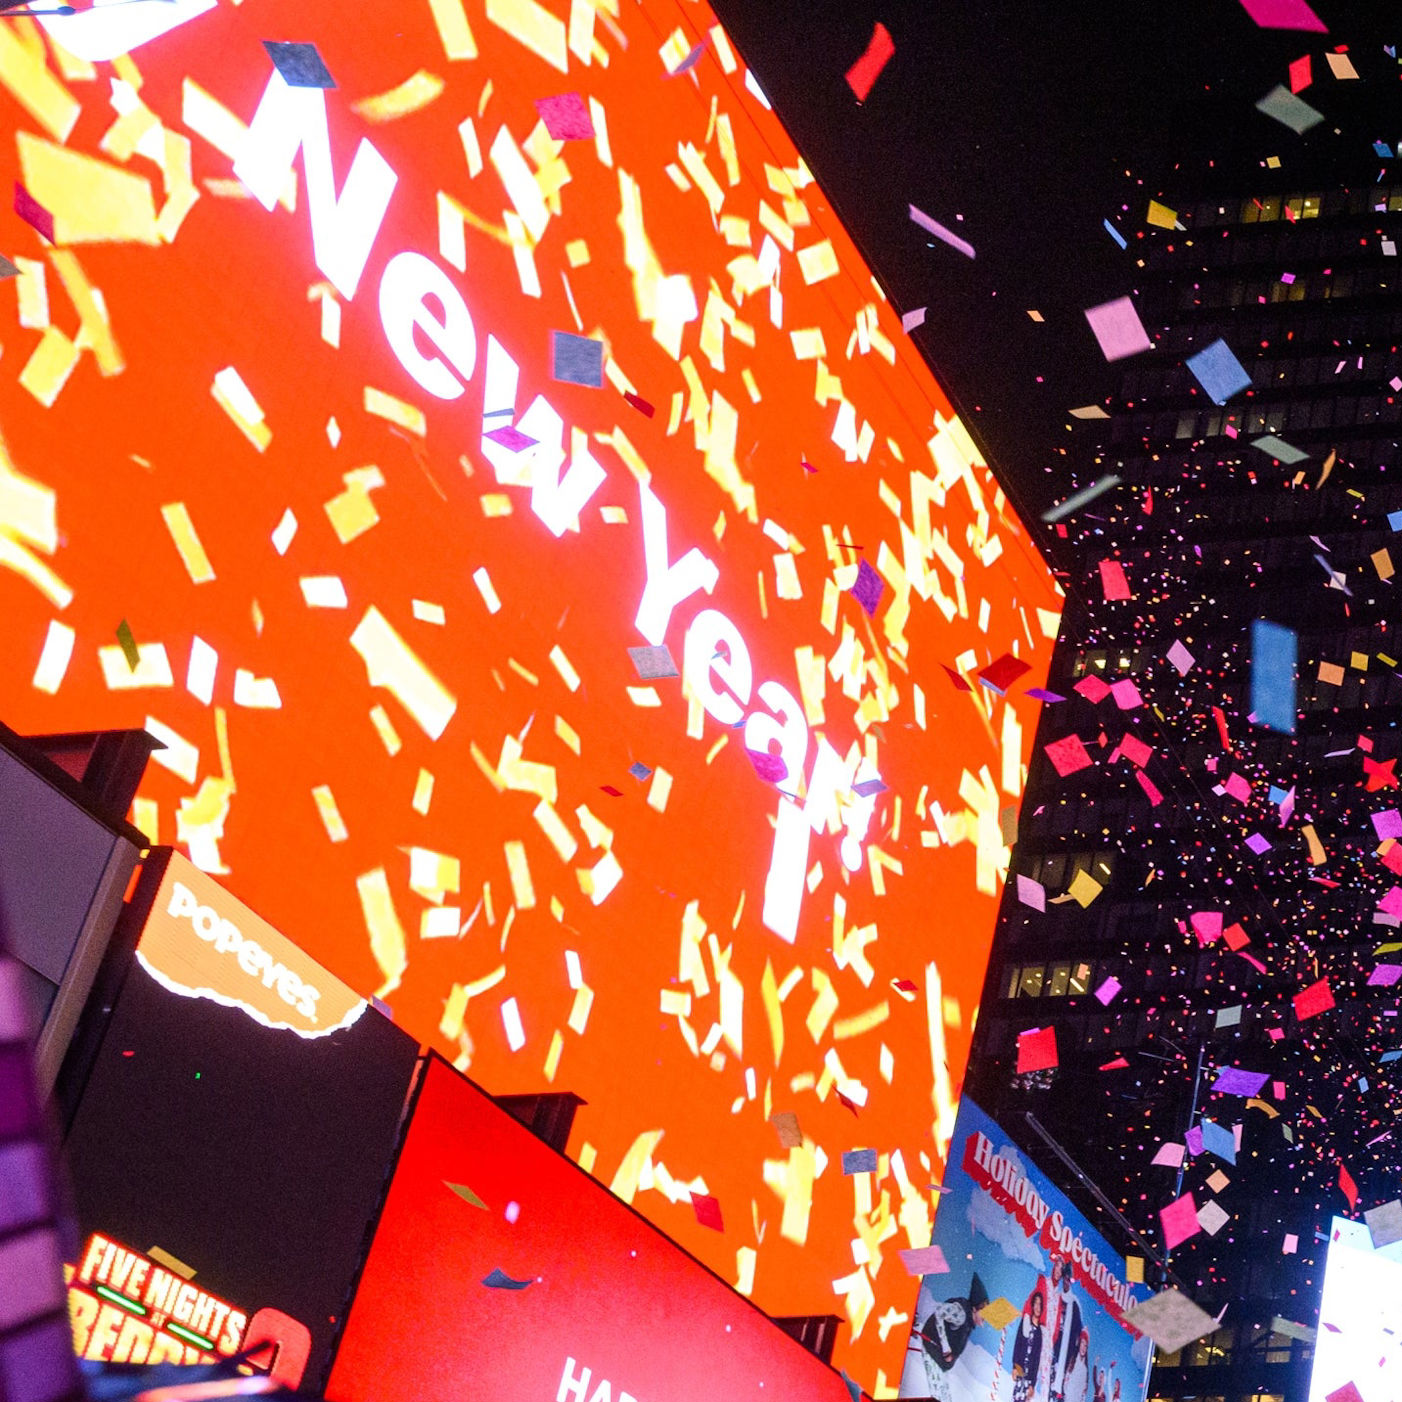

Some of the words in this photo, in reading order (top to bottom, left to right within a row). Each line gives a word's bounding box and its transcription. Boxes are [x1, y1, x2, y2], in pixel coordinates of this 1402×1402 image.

[233, 58, 607, 537] New
[79, 1233, 151, 1298] FIVE
[143, 1267, 247, 1356] NIGHTS
[1046, 1211, 1140, 1315] Spectacula
